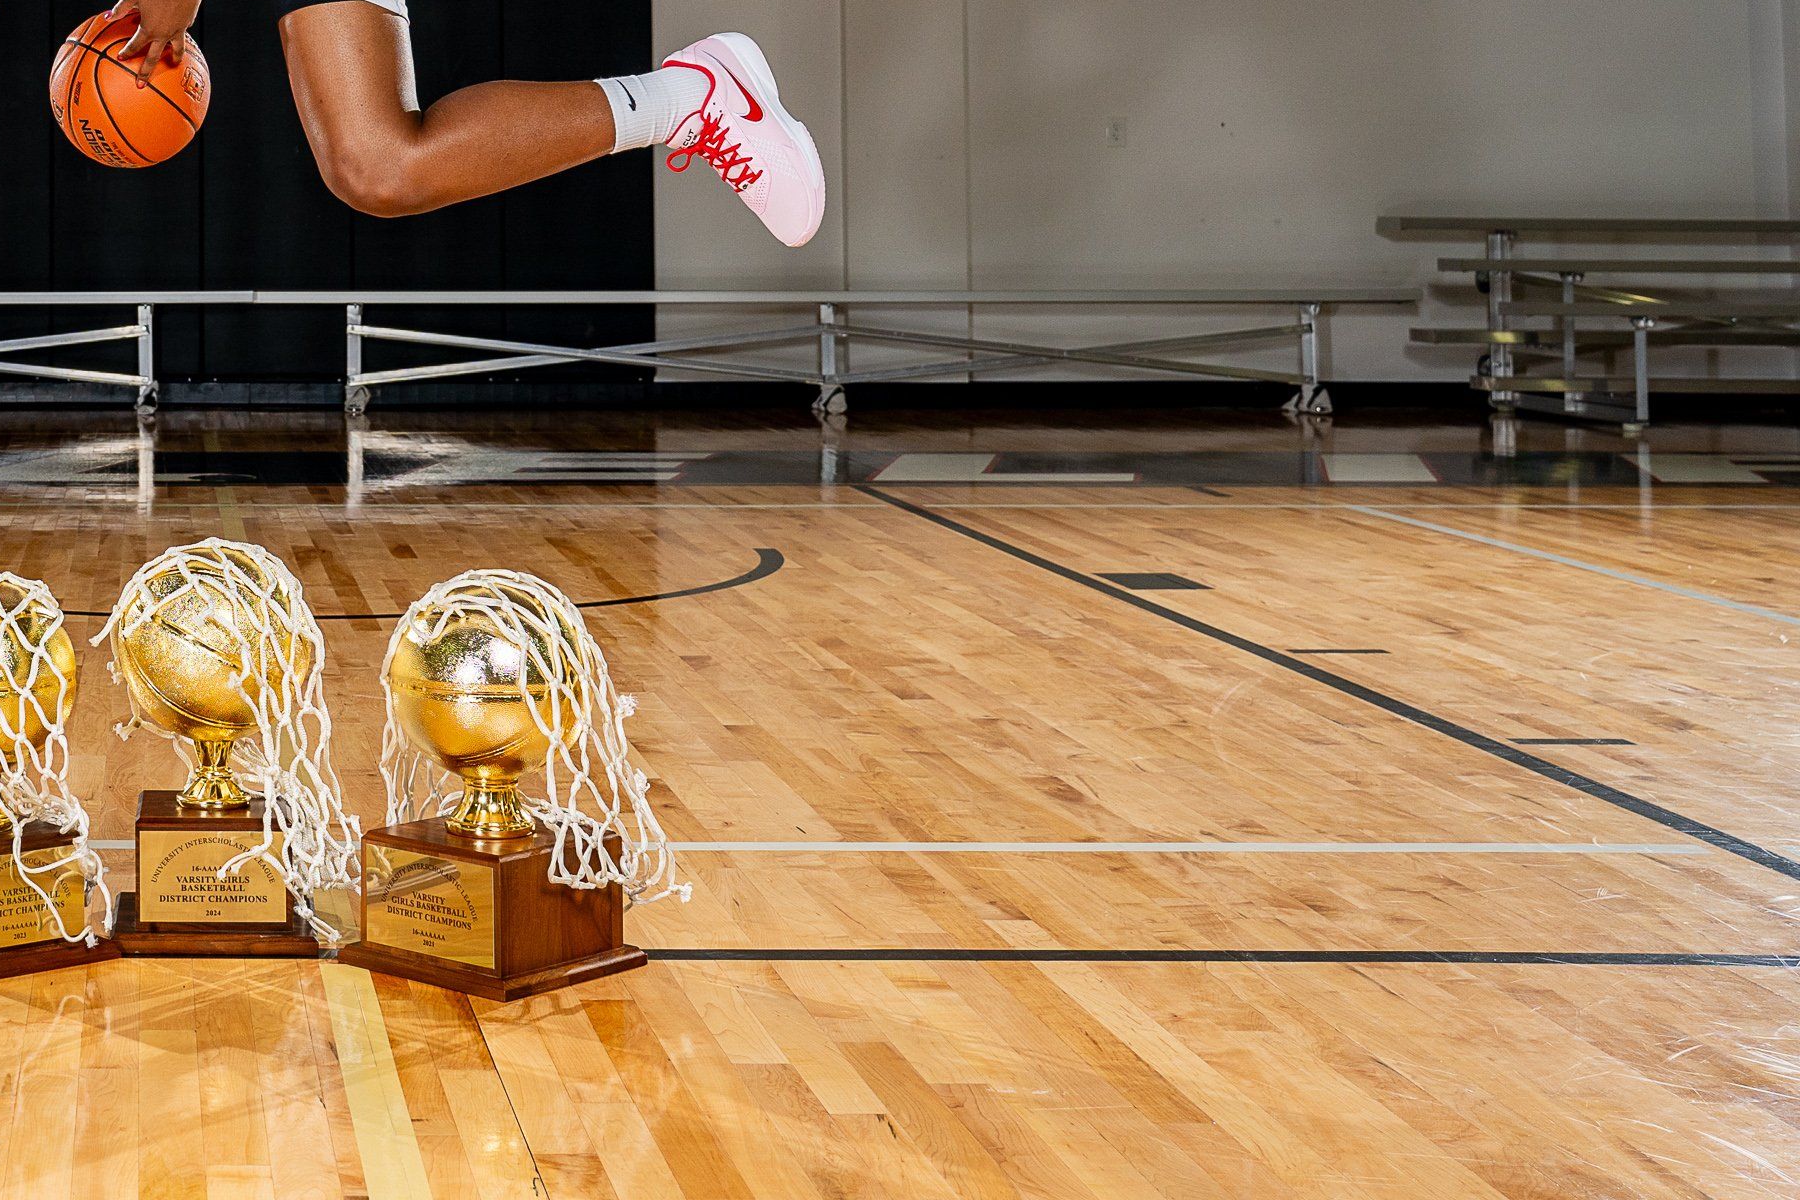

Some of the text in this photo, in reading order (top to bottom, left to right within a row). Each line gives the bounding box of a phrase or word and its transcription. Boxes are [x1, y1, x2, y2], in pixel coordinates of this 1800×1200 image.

[151, 845, 183, 883] UNIVERSITY
[184, 837, 250, 852] INTERSCHOLAST
[181, 884, 245, 892] BASKETBALL
[381, 867, 406, 902] UNIVERSITY
[461, 890, 478, 922] LEAGUE
[159, 895, 268, 903] DISTRICT CHAMPIONS
[391, 896, 467, 918] GIRLS BASKETBALL
[412, 891, 446, 905] VARSITY
[15, 900, 65, 915] CHAMPINS
[387, 905, 472, 930] DISTRICT CHAMPIONS
